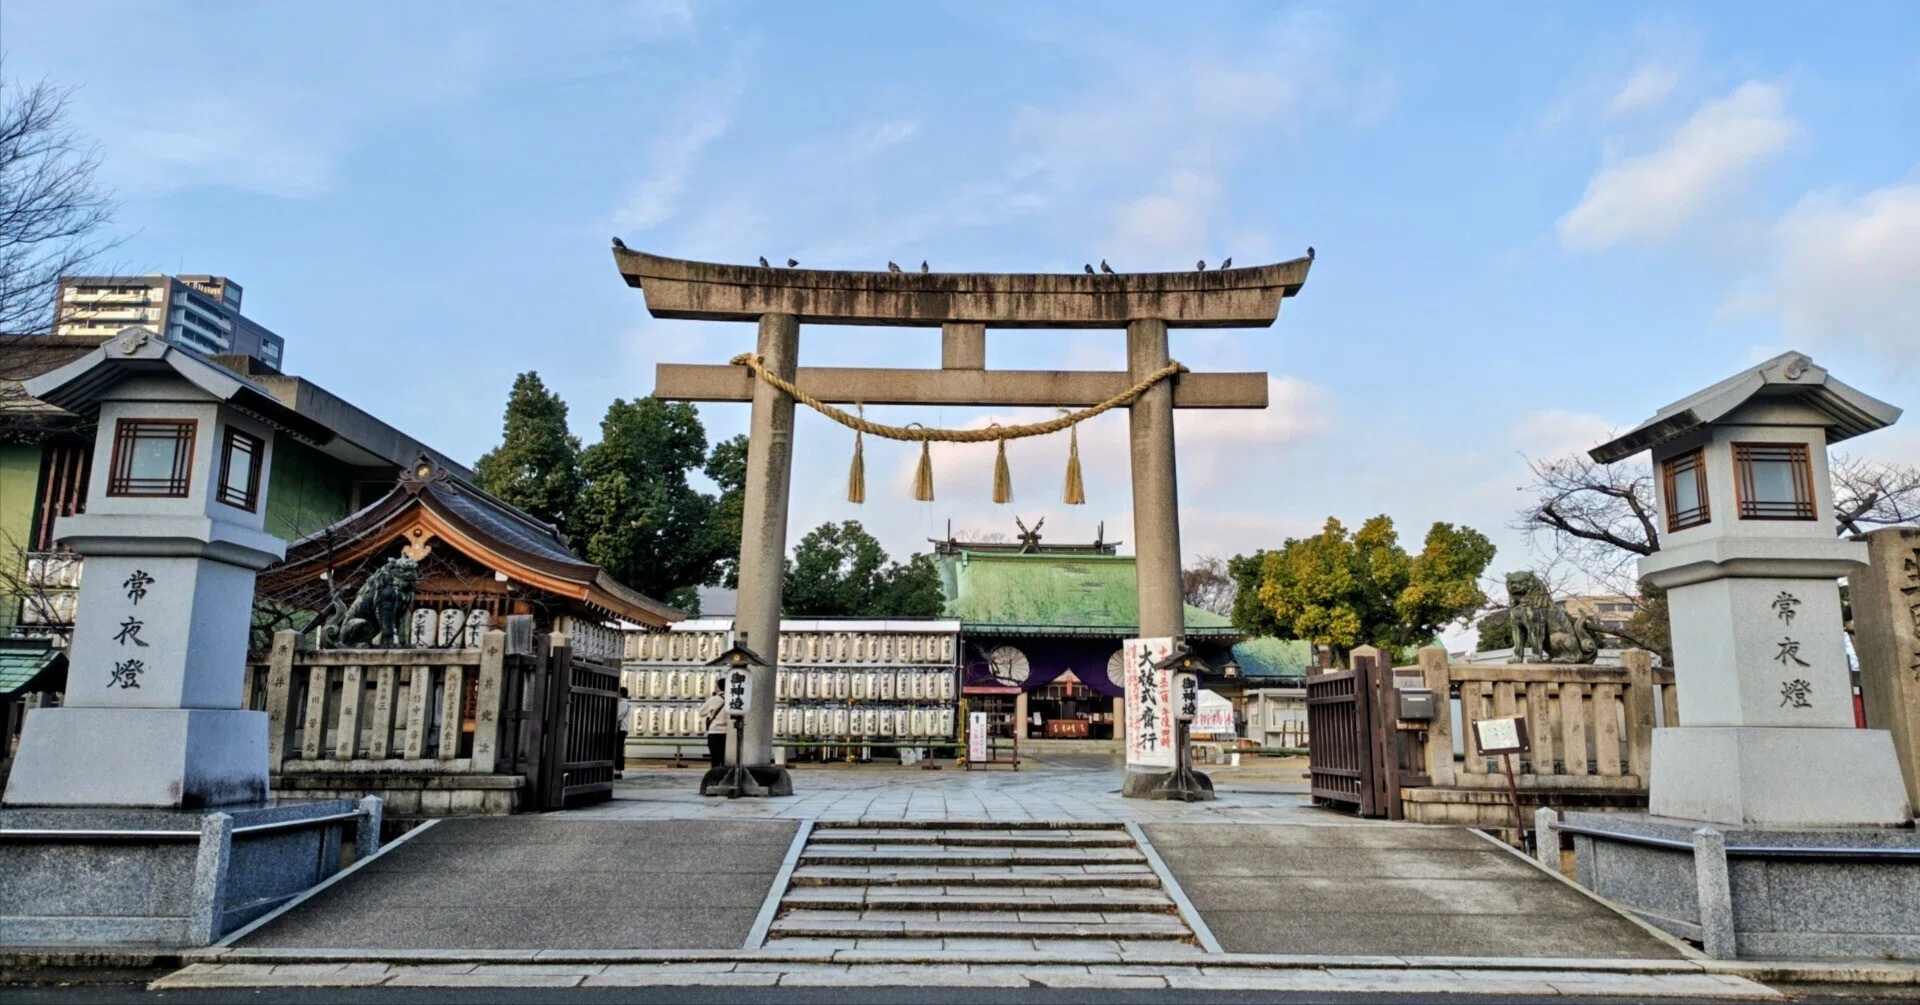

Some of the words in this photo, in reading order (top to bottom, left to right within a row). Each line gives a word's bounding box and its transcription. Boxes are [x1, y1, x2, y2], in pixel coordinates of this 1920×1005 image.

[107, 569, 155, 689] 常夜燈
[1771, 591, 1812, 708] 常夜燈
